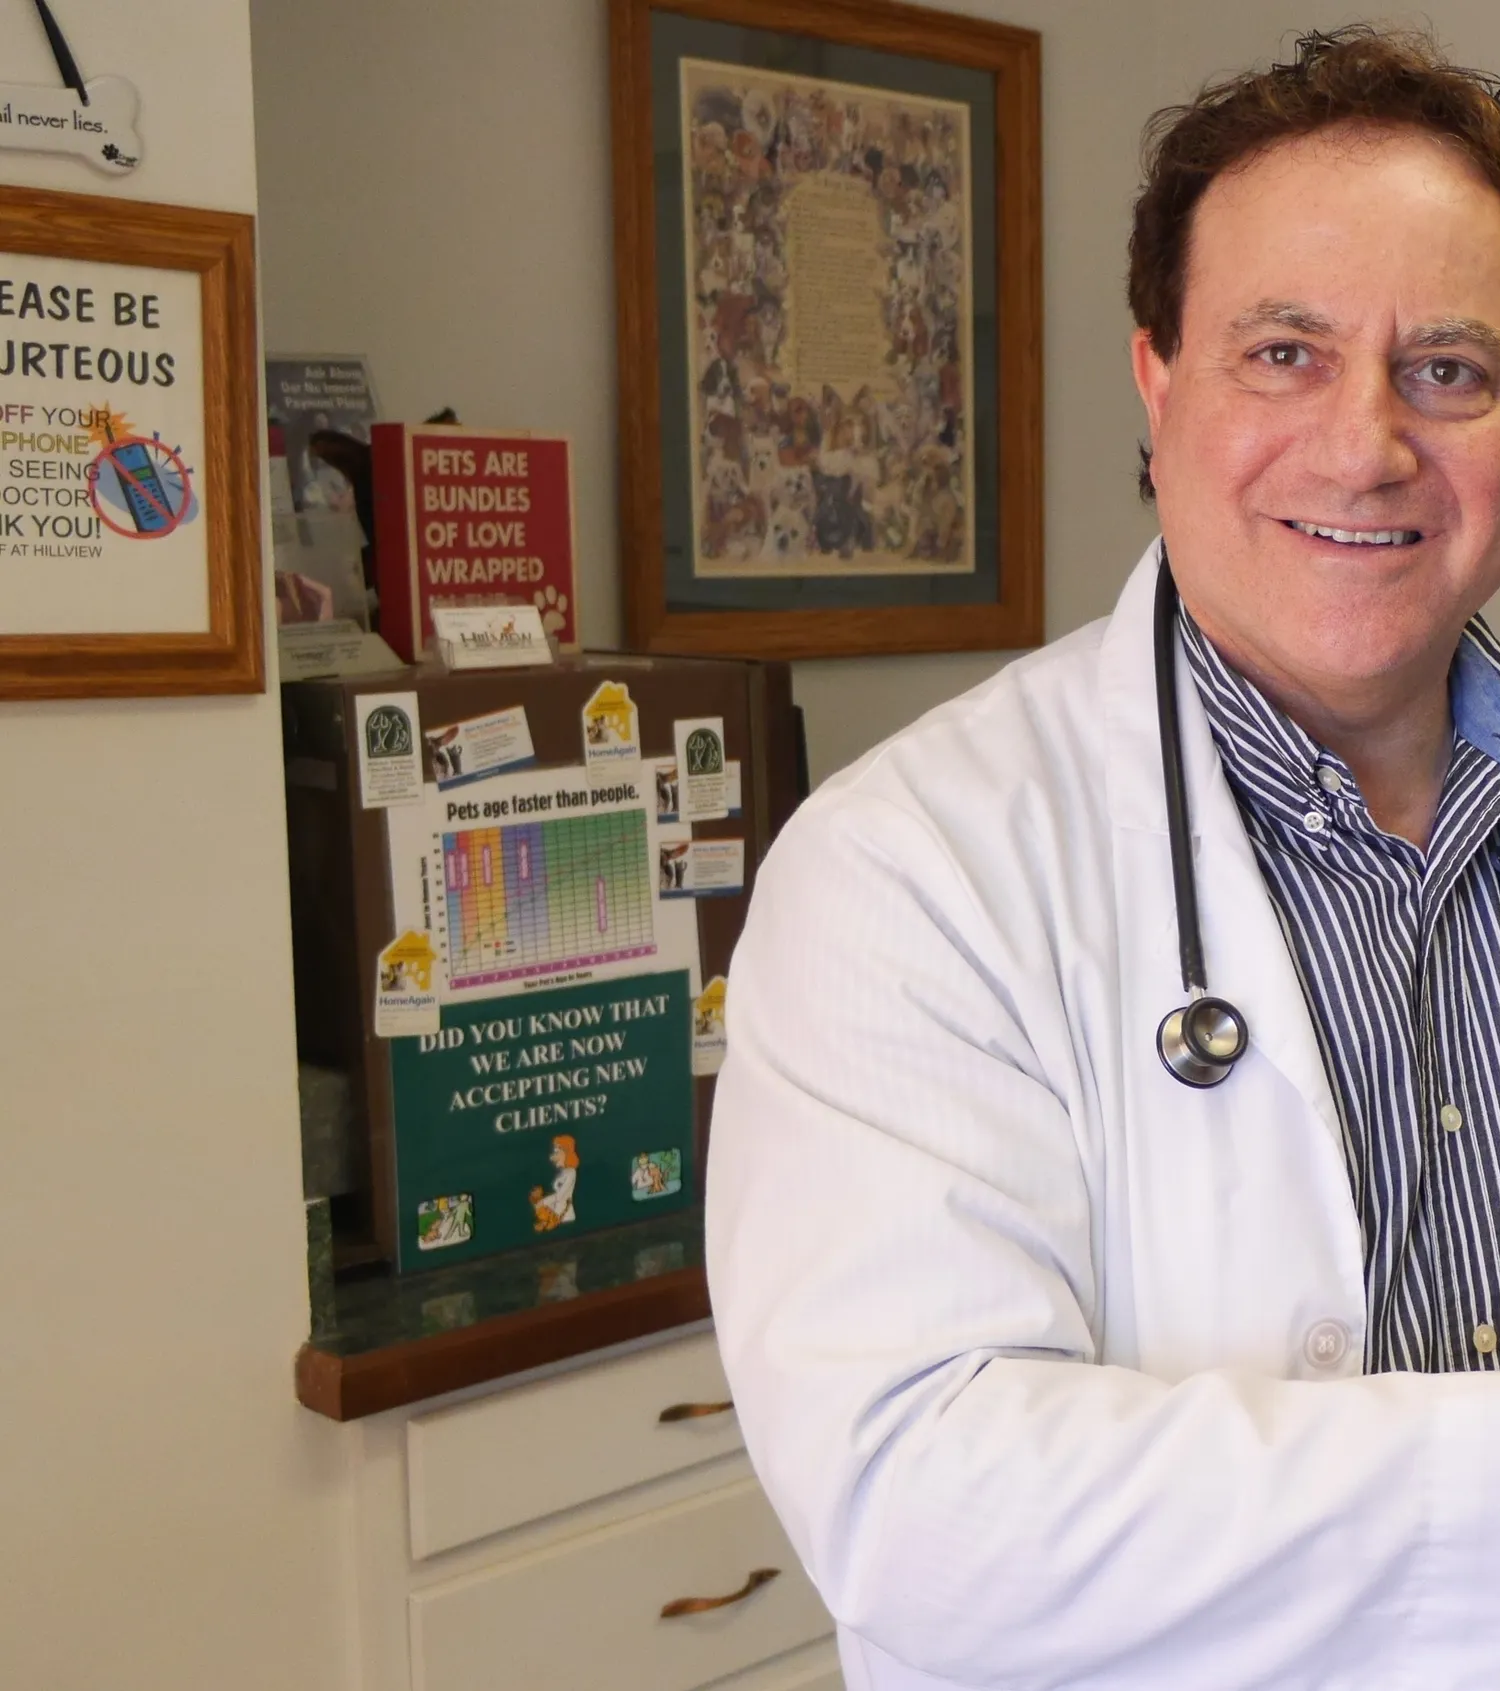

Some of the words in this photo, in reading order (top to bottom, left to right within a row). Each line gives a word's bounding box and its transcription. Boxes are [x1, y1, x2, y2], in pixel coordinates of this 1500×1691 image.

[18, 112, 69, 129] never
[73, 109, 108, 134] lies.
[0, 279, 95, 324] EASE
[114, 291, 160, 329] BE
[0, 339, 176, 388] URTEOUS
[0, 403, 35, 425] FF
[42, 406, 112, 429] YOUR
[1, 430, 91, 456] PHONE
[9, 458, 101, 482] SEEING
[422, 448, 477, 477] PETS
[484, 451, 530, 478] ARE
[0, 486, 97, 509] OCTOR!
[423, 484, 531, 513] BUNDLES
[0, 513, 25, 538] K
[31, 514, 102, 540] YOU!
[425, 521, 458, 549] OF
[467, 520, 526, 548] LOVE
[11, 543, 30, 557] AT
[33, 543, 103, 559] HILLVIEW
[426, 556, 545, 585] WRAPPED
[446, 800, 480, 823] Pets
[483, 800, 509, 819] age
[512, 795, 553, 815] faster
[556, 790, 588, 809] than
[591, 783, 640, 807] people.
[380, 995, 436, 1007] HomeAgain
[419, 1027, 465, 1053] DID
[470, 1016, 523, 1045] YOU
[529, 1005, 605, 1036] KNOW
[609, 994, 670, 1022] THAT
[470, 1050, 511, 1075] WE
[516, 1042, 564, 1069] ARE
[571, 1030, 627, 1059] NOW
[450, 1066, 590, 1113] ACCEPTING
[596, 1056, 649, 1085] NEW
[495, 1093, 608, 1134] CLIENTS?
